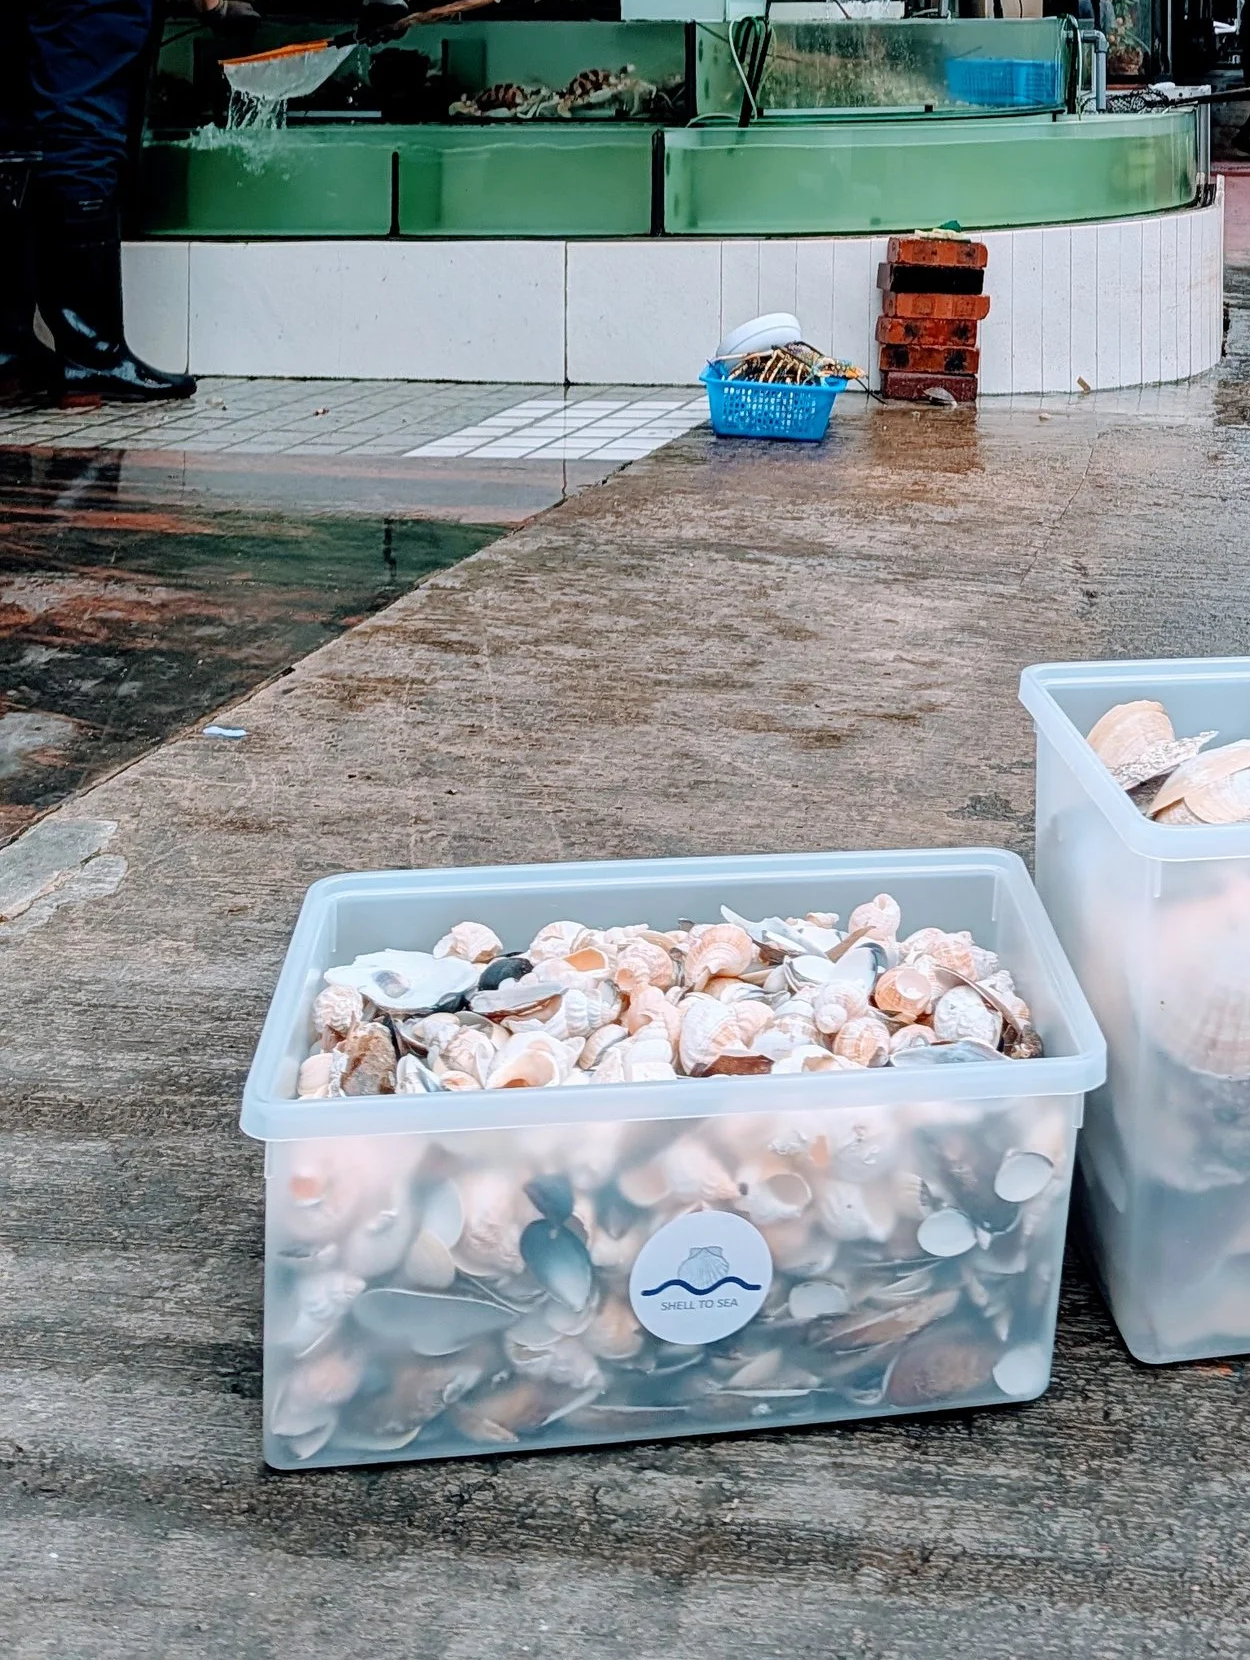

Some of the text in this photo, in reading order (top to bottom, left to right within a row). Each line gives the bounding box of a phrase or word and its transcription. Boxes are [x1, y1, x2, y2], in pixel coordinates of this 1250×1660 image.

[660, 1298, 738, 1311] SHELL TO SEA
